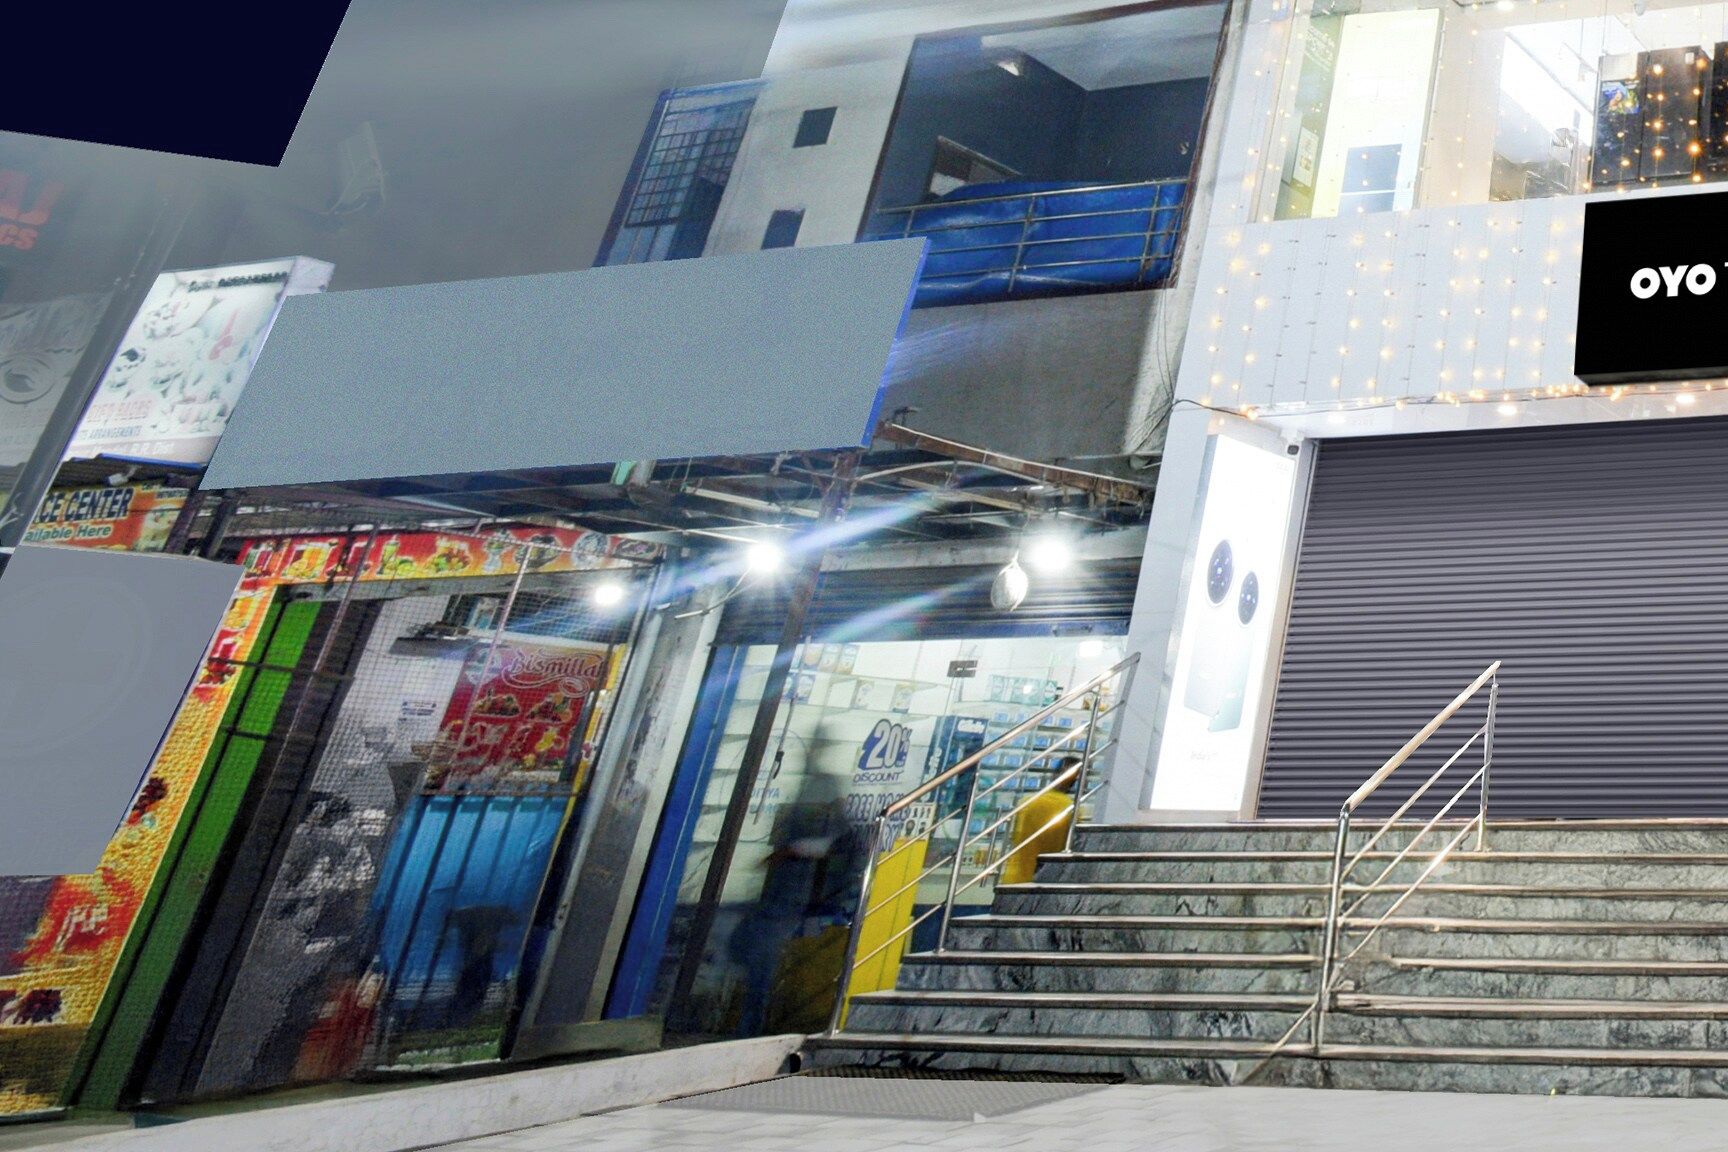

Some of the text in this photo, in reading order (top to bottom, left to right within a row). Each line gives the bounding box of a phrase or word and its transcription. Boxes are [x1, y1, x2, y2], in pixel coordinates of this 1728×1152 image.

[1629, 262, 1717, 299] OYO
[34, 487, 135, 524] CE CENTER
[25, 524, 112, 542] ailable Here
[853, 770, 905, 783] DISCOUNT
